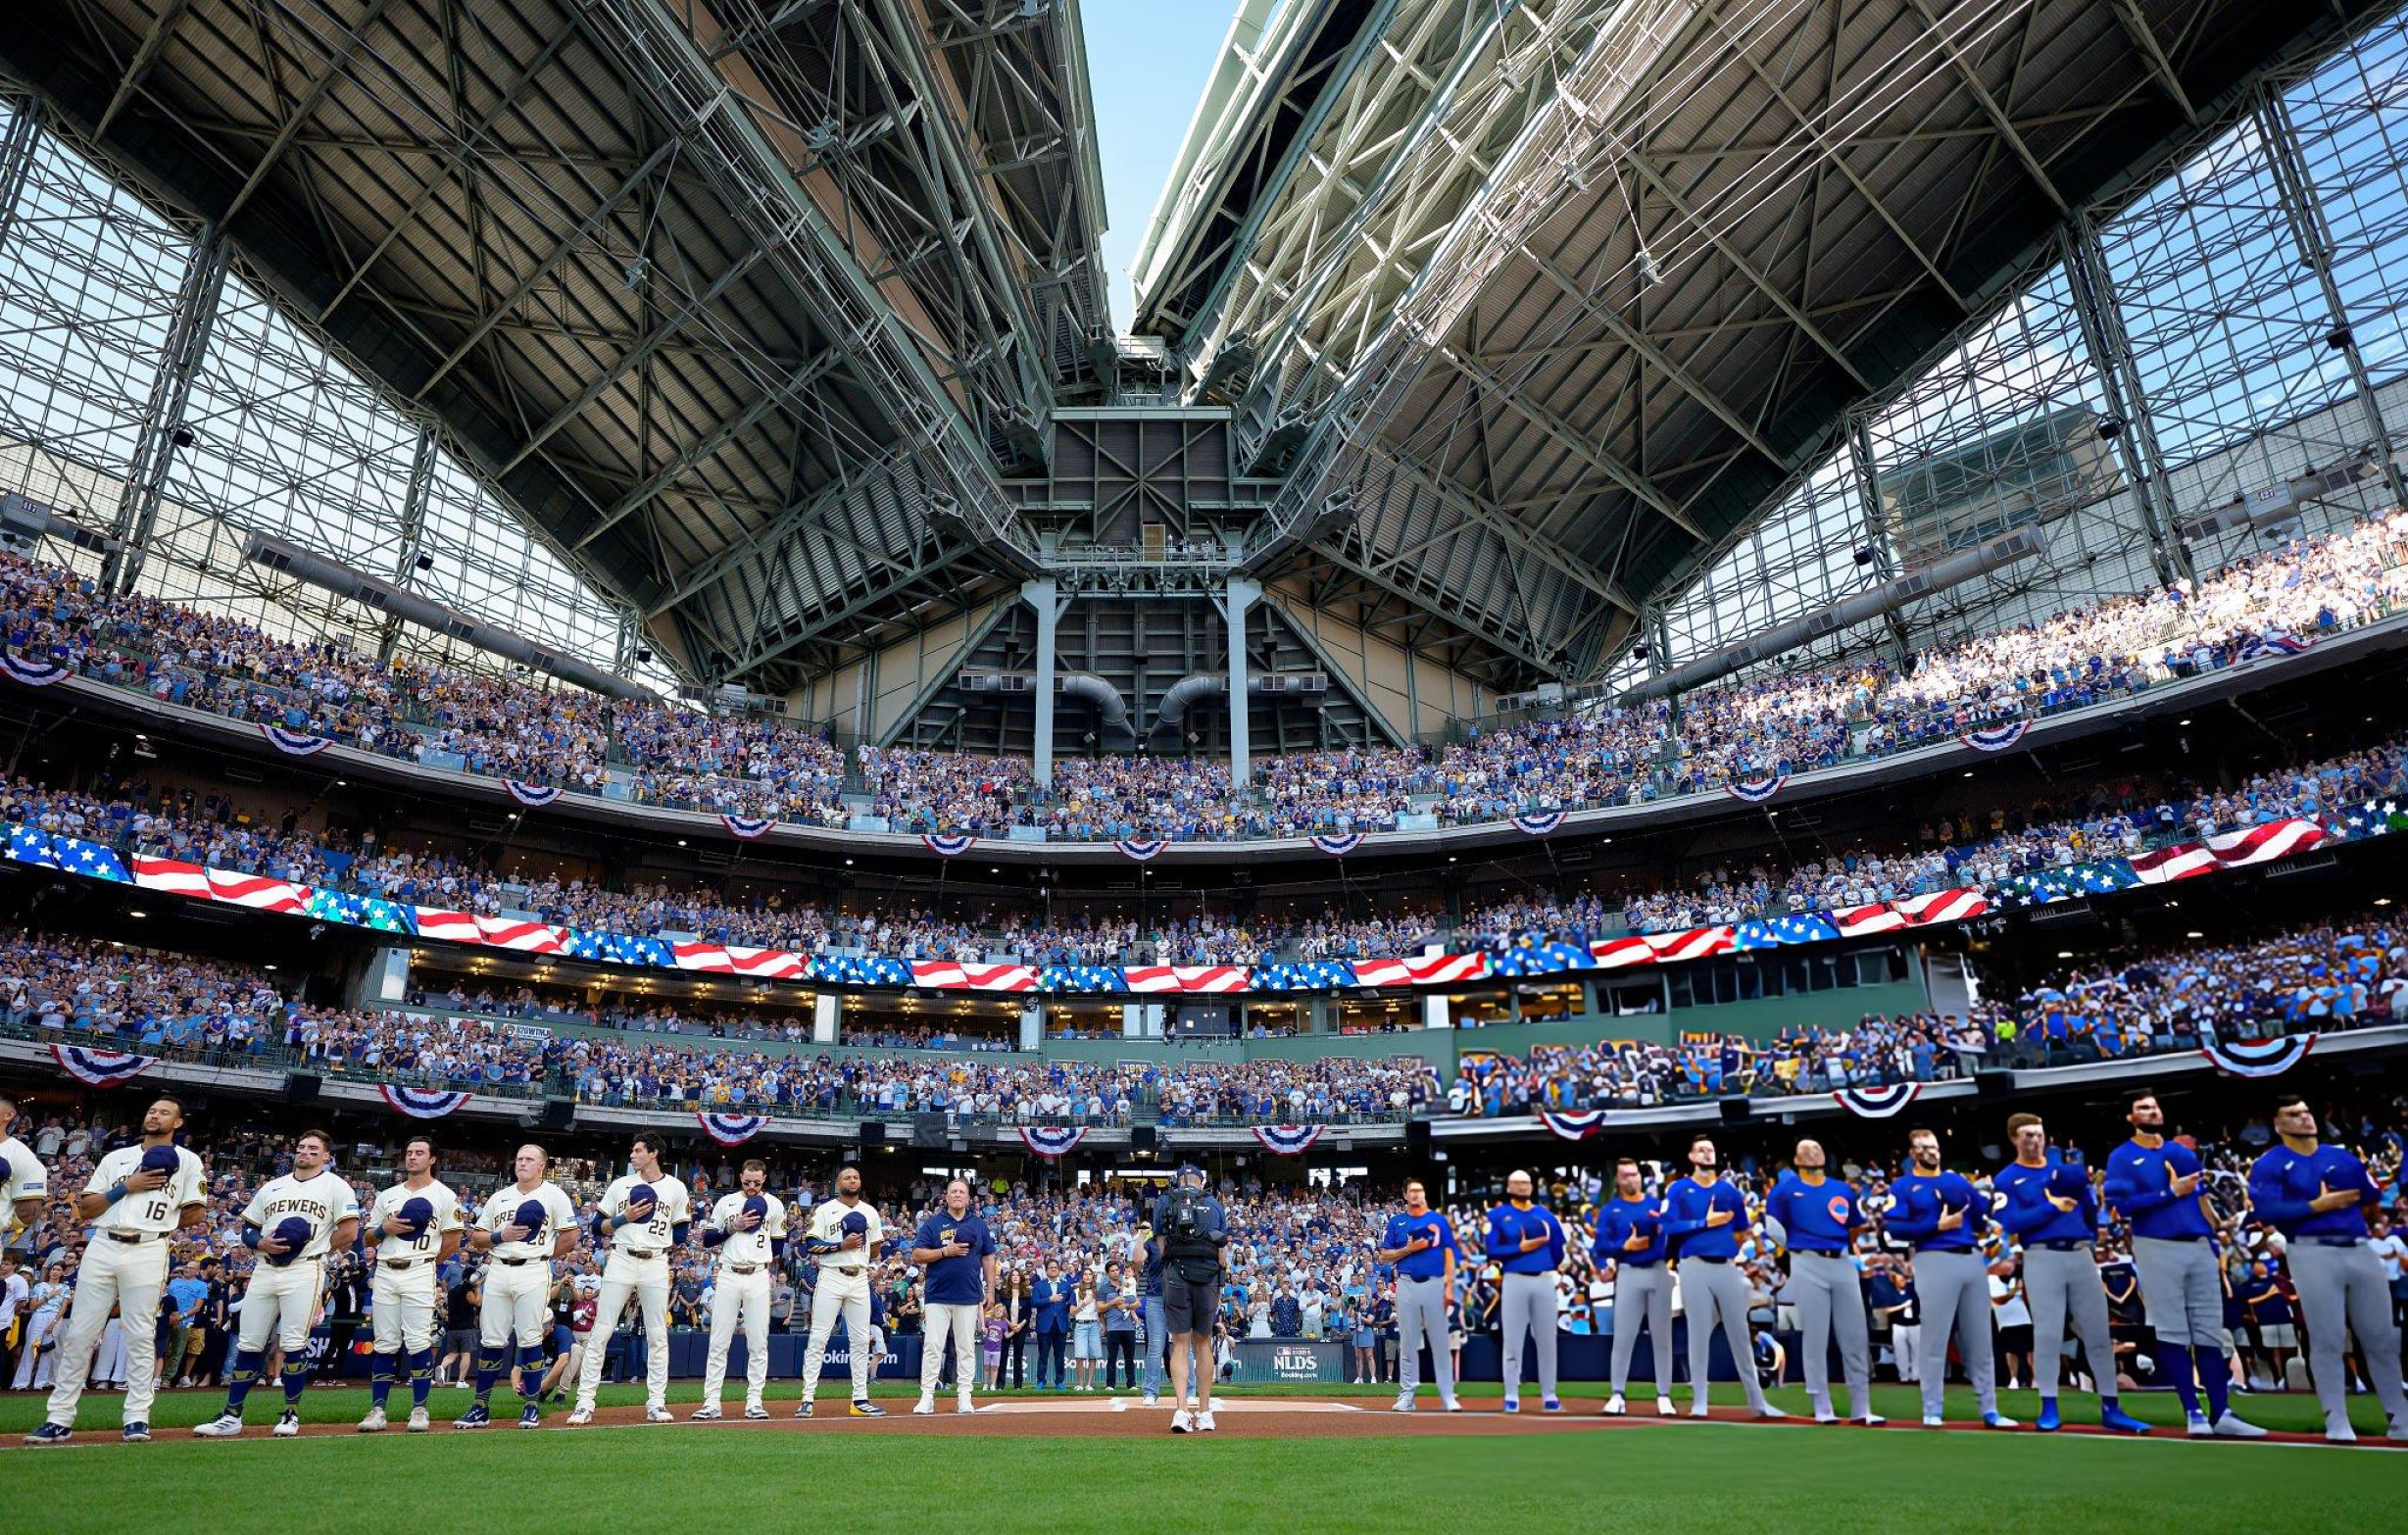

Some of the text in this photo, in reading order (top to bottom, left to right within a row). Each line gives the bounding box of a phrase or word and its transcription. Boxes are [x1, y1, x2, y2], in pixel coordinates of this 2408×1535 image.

[145, 1200, 168, 1221] 16
[264, 1199, 326, 1220] BREWERS
[648, 1218, 667, 1237] 22
[757, 1234, 765, 1249] 2
[1273, 1356, 1318, 1370] NLDS
